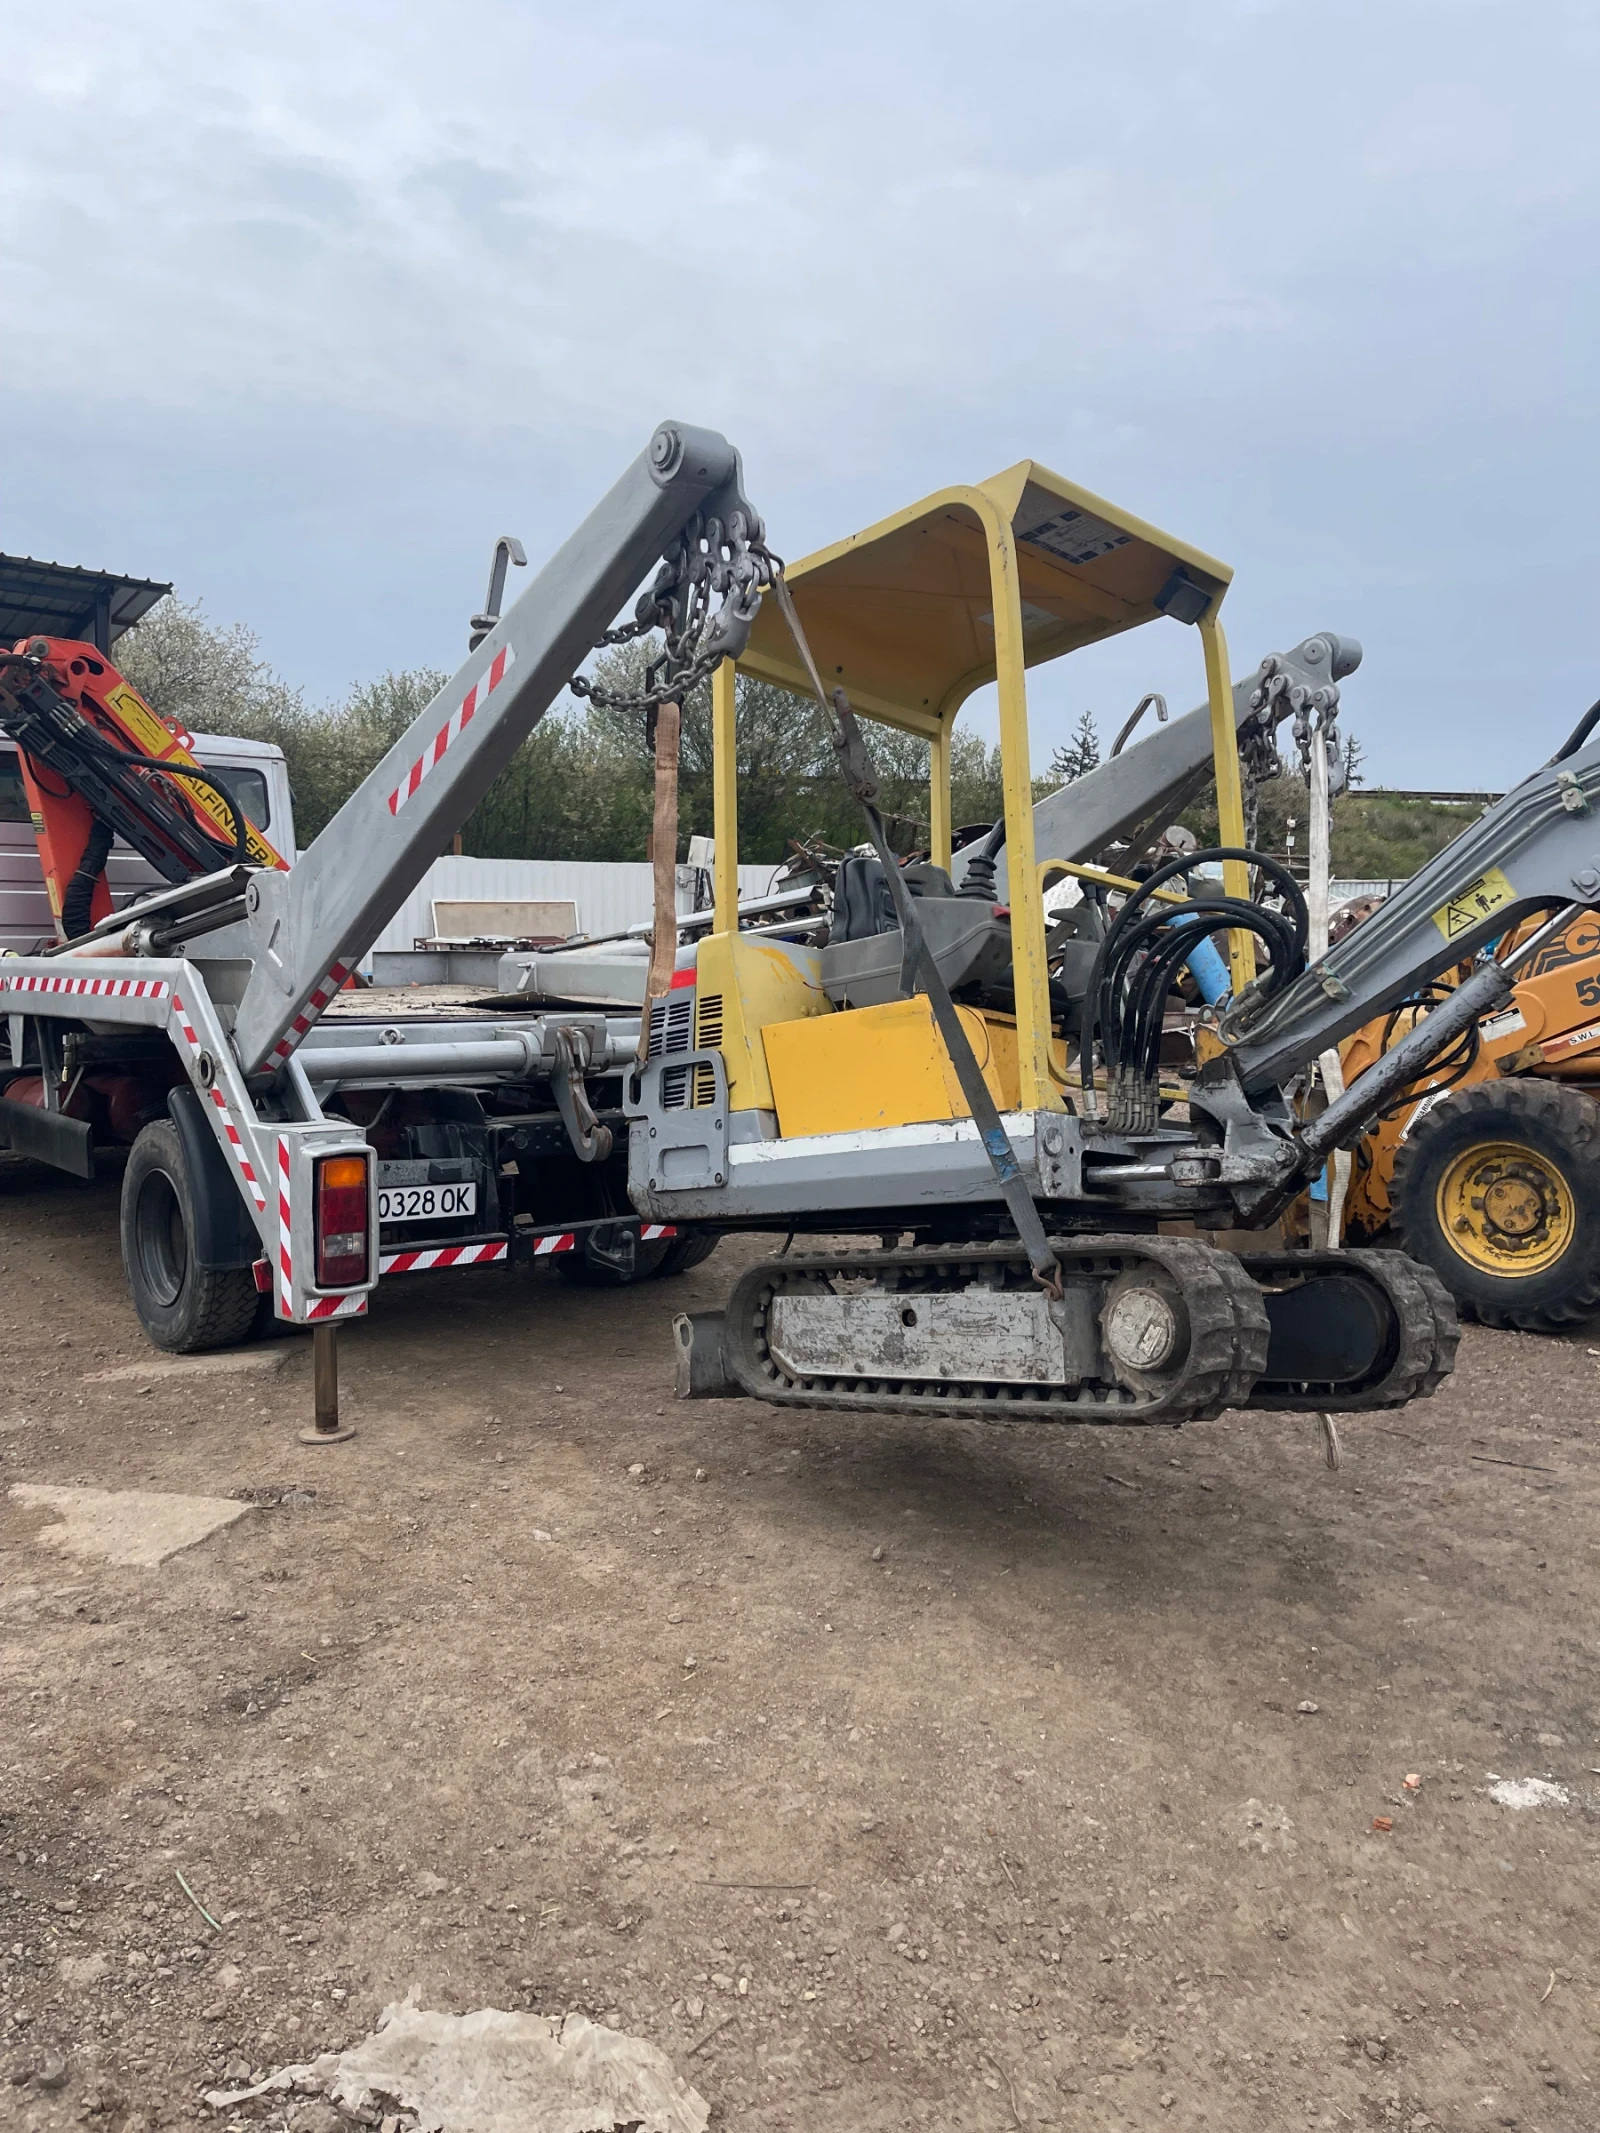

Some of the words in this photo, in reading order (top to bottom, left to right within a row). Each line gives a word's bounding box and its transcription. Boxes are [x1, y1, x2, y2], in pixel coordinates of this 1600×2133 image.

[179, 763, 269, 862] ALFINER
[1575, 974, 1600, 1007] 5
[379, 1190, 435, 1218] 0328
[441, 1187, 470, 1213] OK
